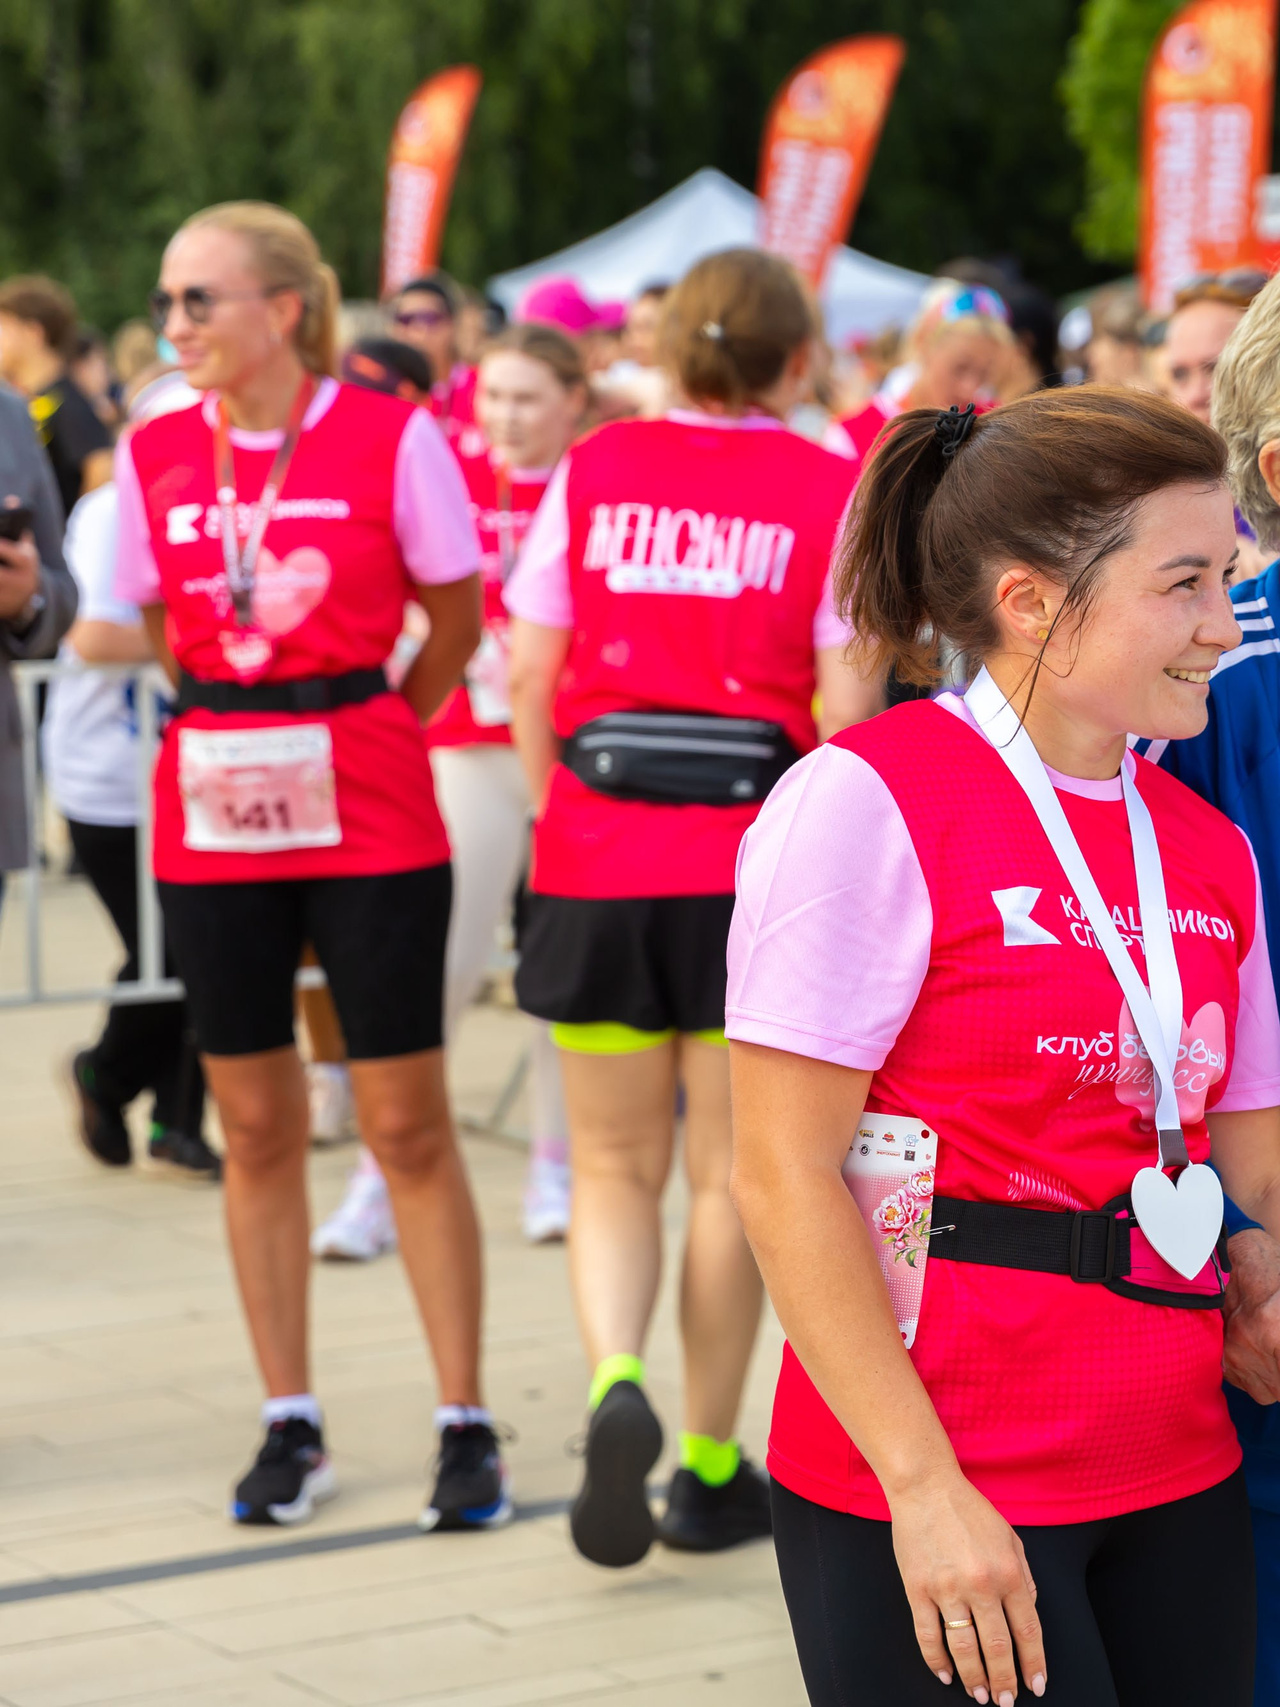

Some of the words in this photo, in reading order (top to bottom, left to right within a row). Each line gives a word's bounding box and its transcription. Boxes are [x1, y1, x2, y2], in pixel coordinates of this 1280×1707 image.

[1036, 1031, 1114, 1061] клуб
[1121, 1032, 1226, 1069] беовых
[1068, 1062, 1209, 1100] принцсс
